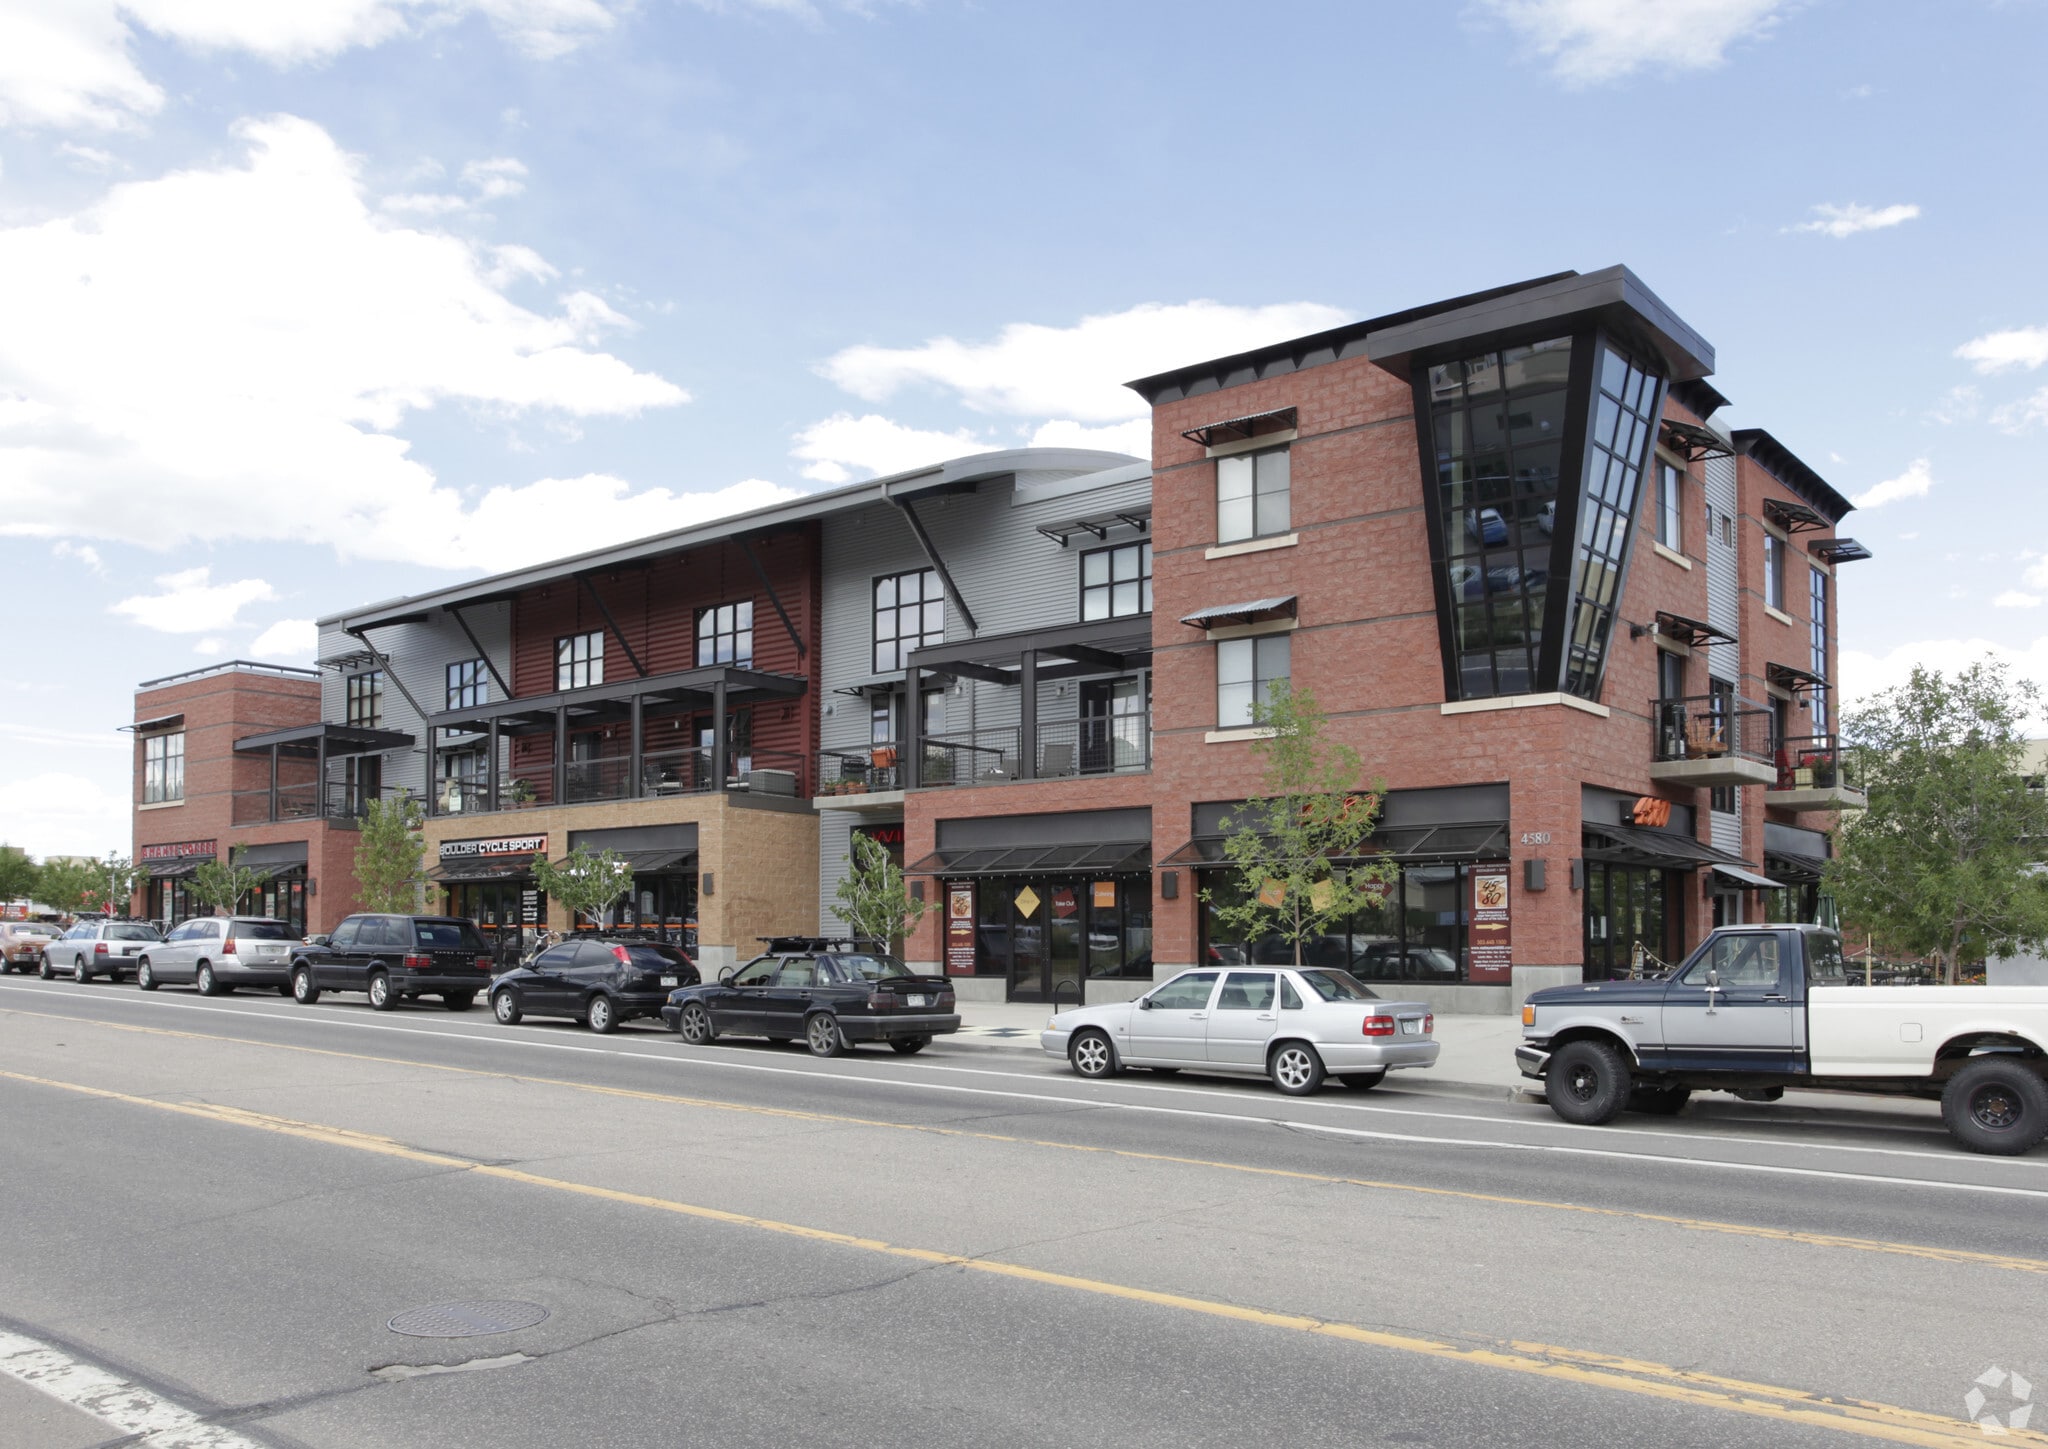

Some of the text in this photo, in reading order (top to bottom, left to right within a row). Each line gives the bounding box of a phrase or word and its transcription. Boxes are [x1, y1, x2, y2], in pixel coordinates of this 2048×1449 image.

[1520, 832, 1550, 844] 4580
[182, 842, 216, 854] COFFEE
[440, 839, 541, 855] BOULDER CYCLE SPORT
[1482, 880, 1500, 892] 45
[1482, 892, 1501, 905] 80
